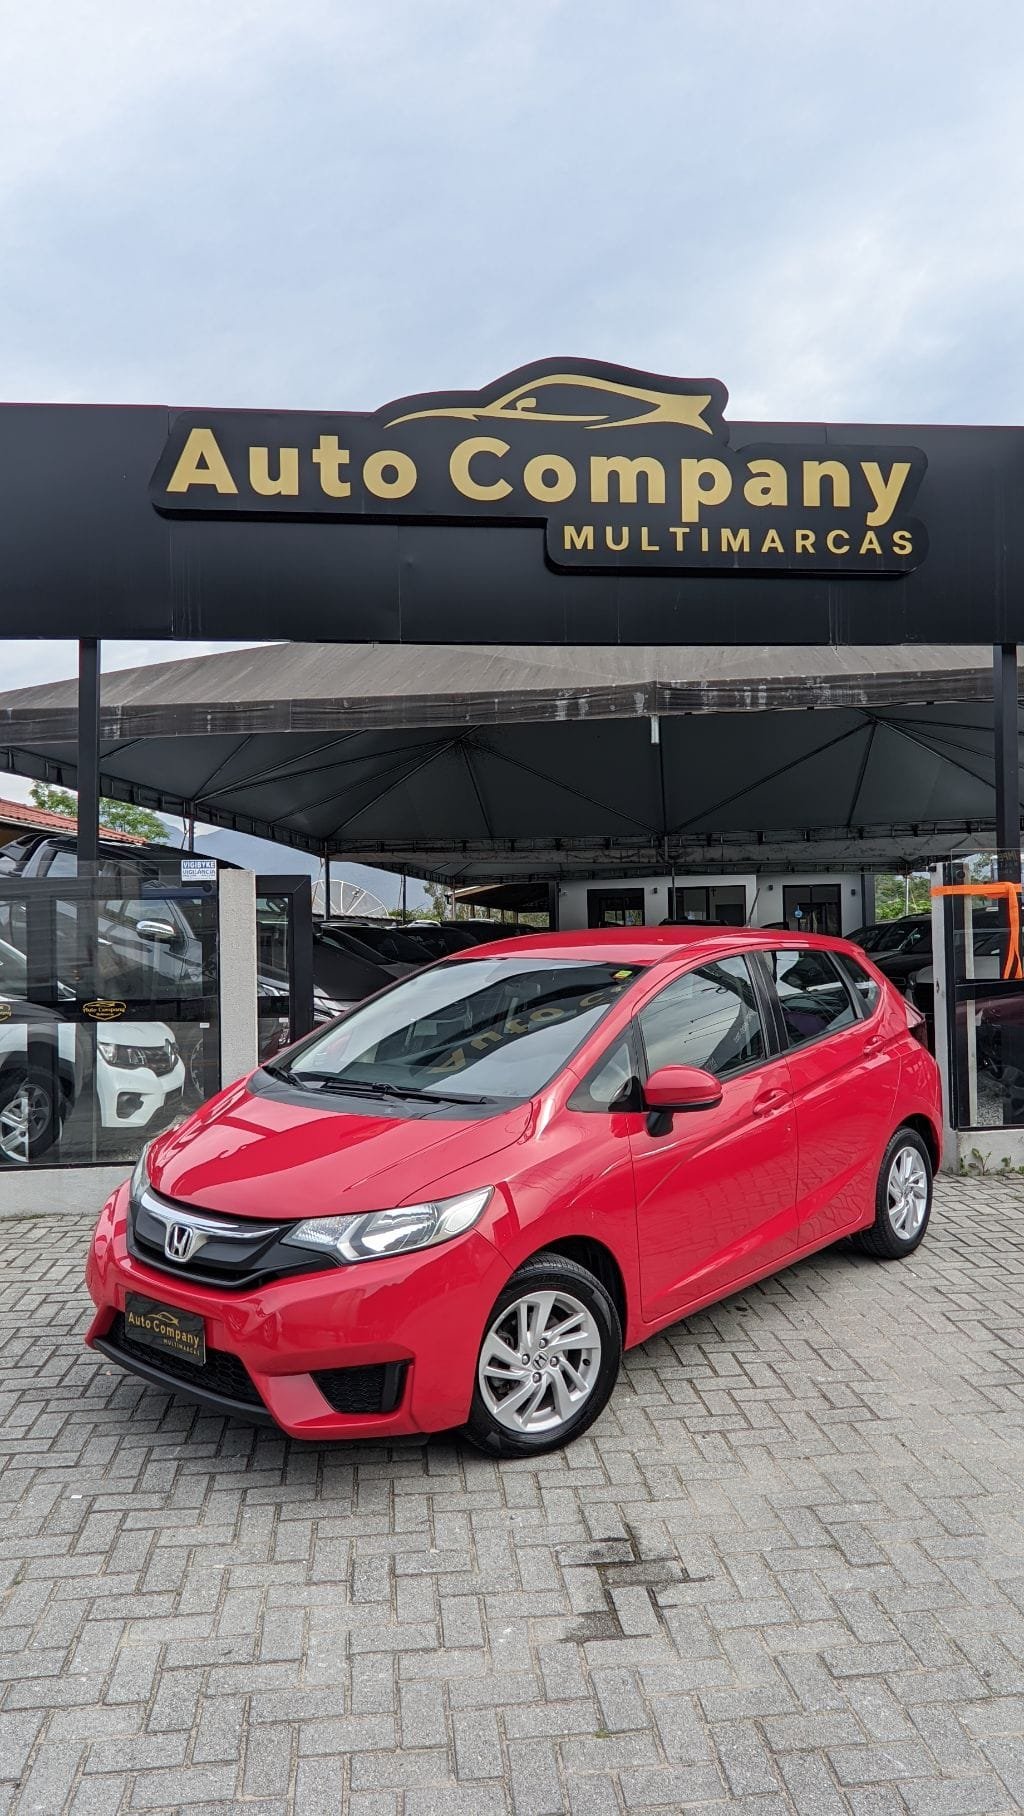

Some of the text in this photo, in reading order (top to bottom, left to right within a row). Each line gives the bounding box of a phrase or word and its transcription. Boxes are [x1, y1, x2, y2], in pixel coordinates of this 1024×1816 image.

[166, 428, 912, 527] Auto Company
[563, 525, 914, 555] MULTIMARCAS
[128, 1311, 199, 1348] Auto Company
